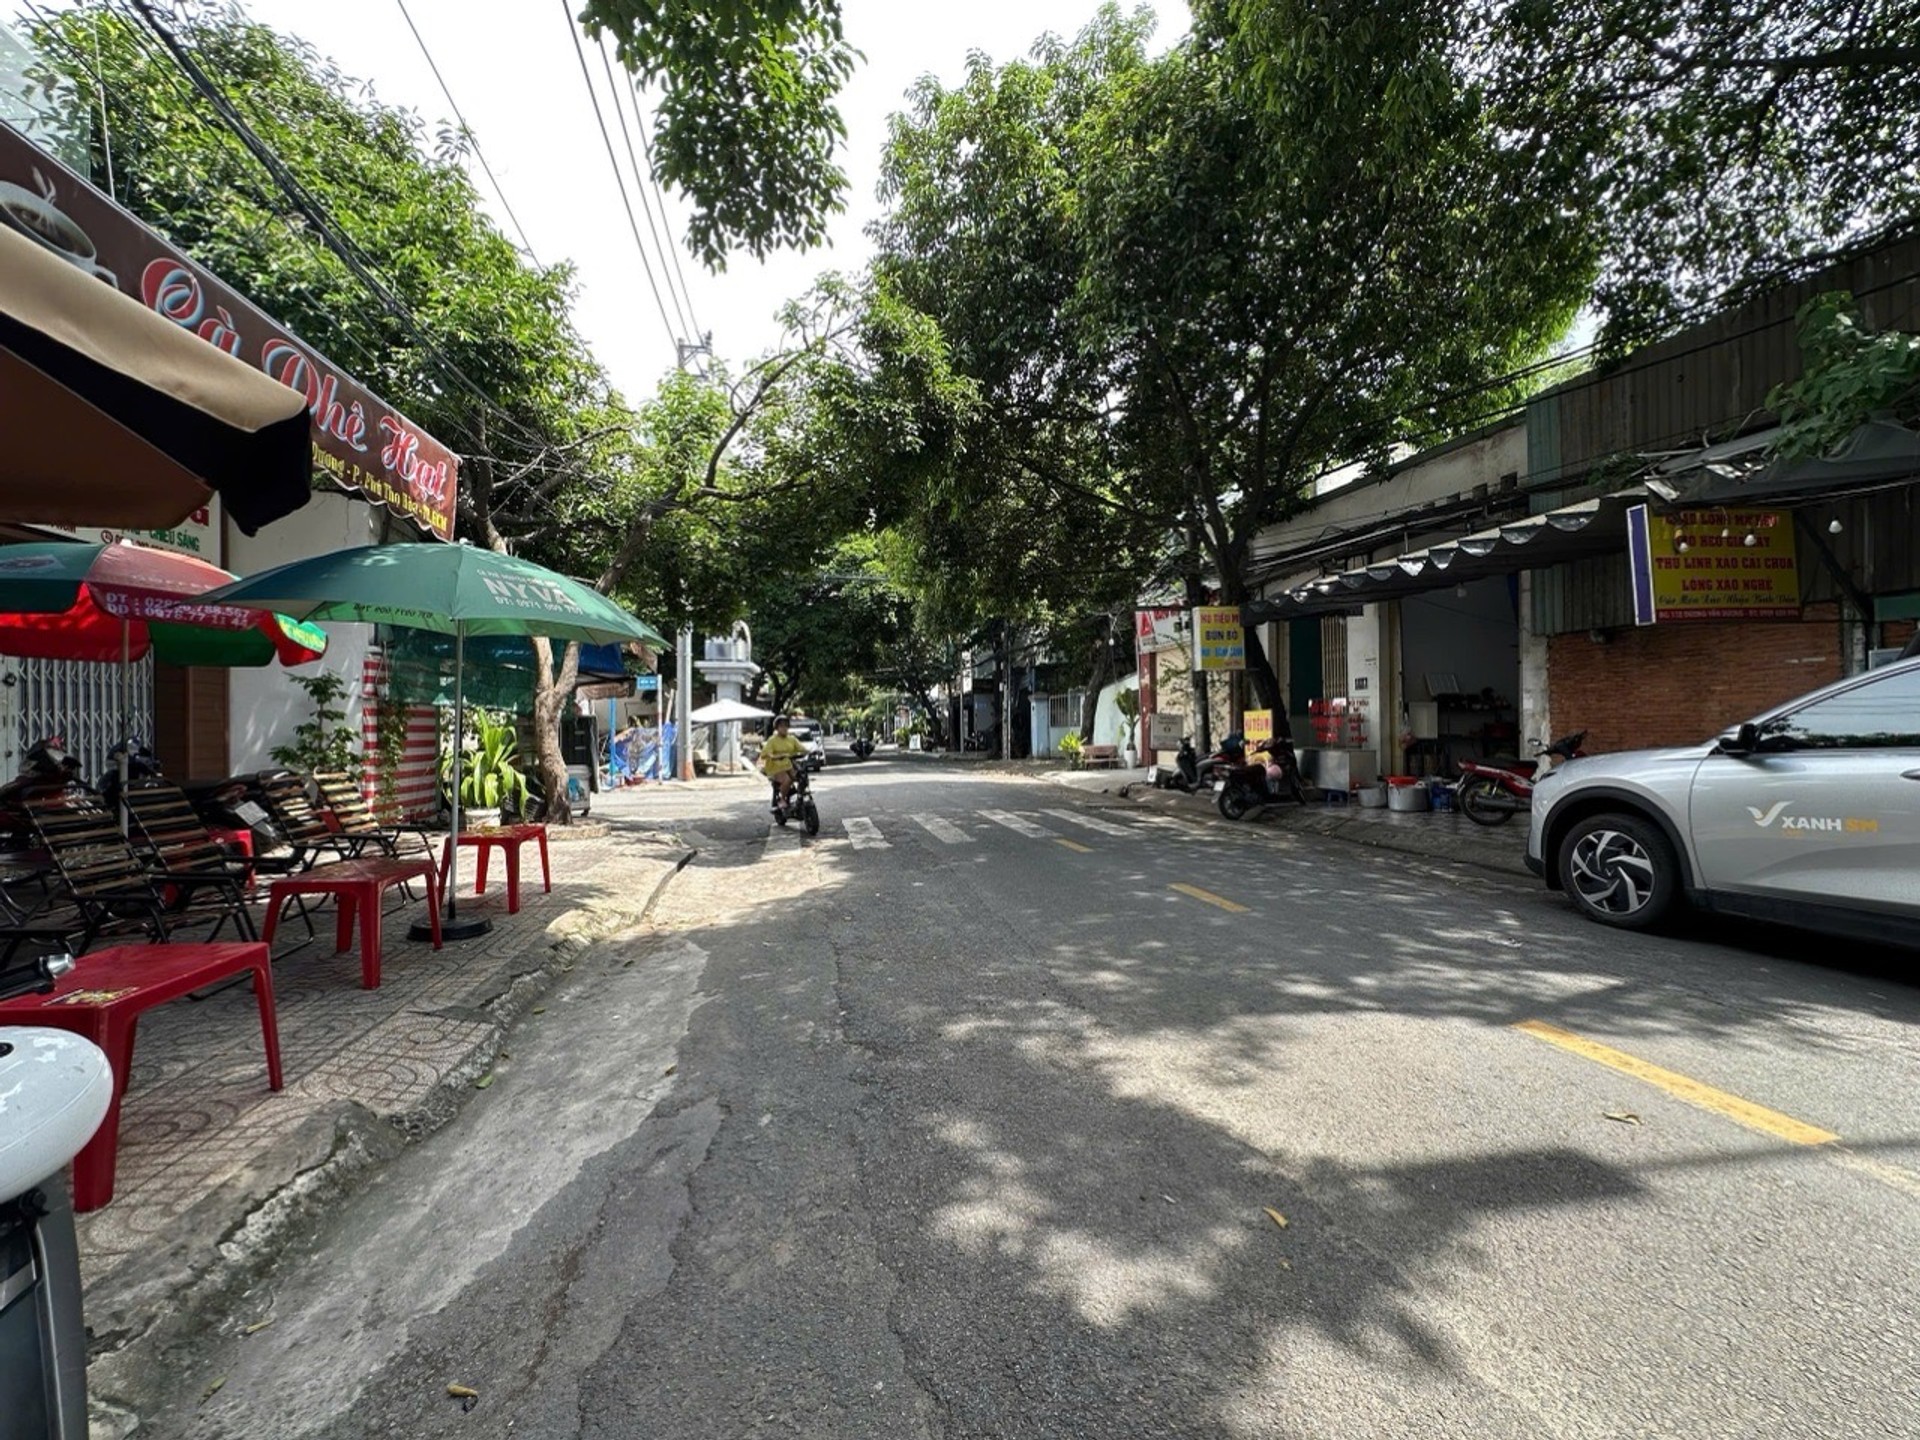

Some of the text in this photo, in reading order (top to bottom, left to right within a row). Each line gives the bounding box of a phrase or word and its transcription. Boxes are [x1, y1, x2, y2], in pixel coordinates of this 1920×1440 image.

[380, 416, 446, 500] Hạt
[177, 529, 199, 551] SÁNG
[483, 577, 577, 607] NYVA
[1782, 816, 1842, 831] XANH
